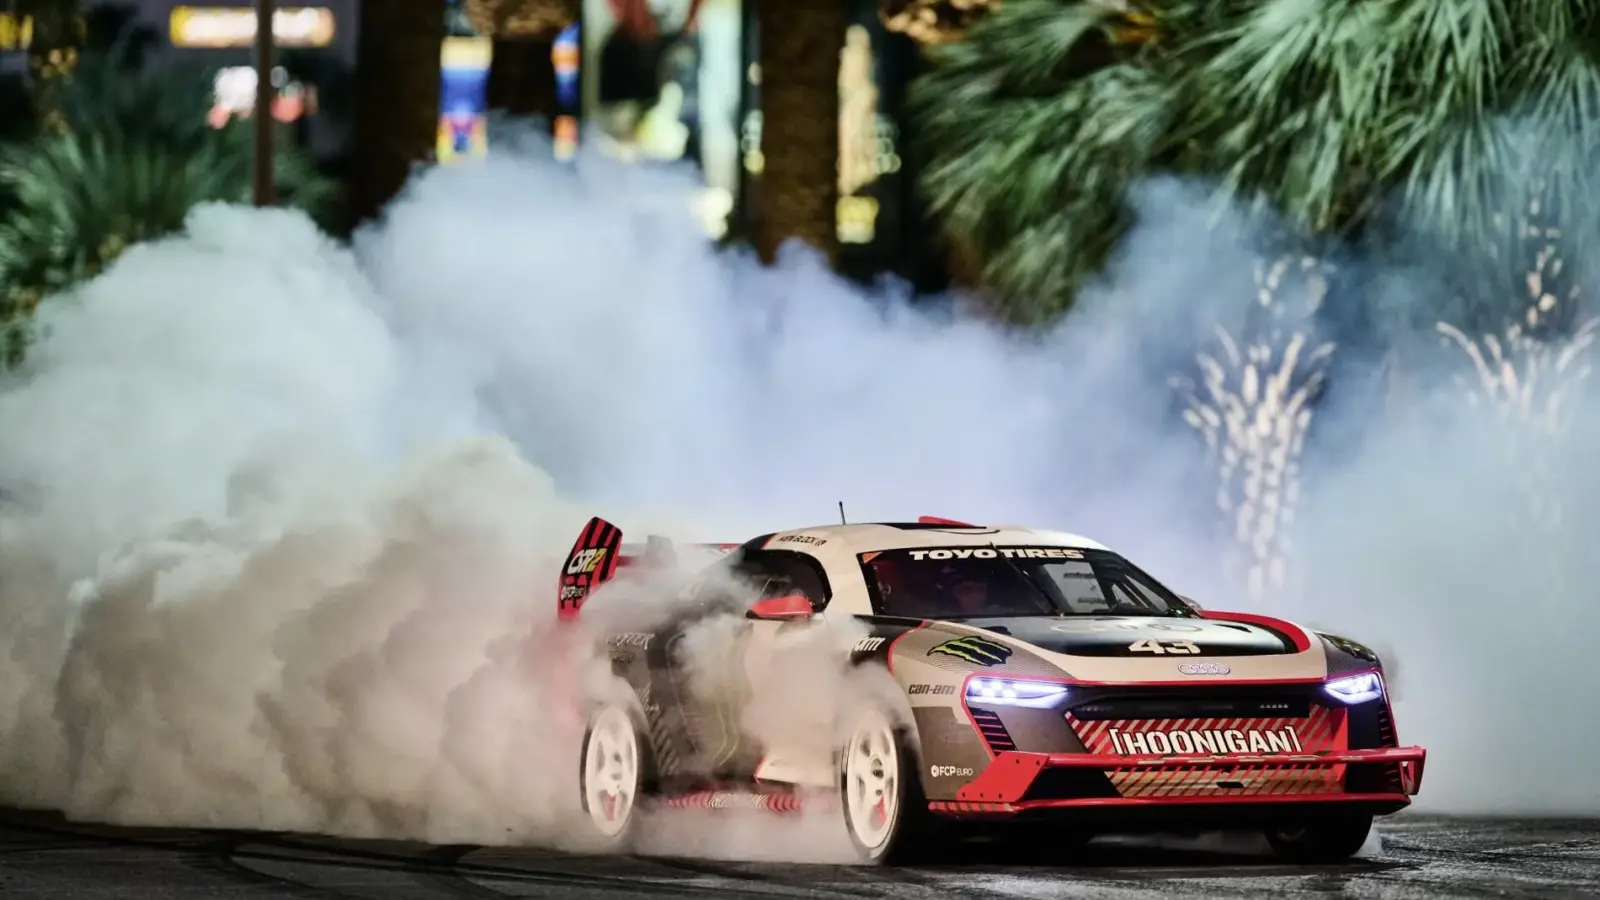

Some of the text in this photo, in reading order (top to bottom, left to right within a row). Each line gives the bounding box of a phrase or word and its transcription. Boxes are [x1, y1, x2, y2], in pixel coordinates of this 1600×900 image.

[909, 549, 1084, 561] TOYO TIRES
[1128, 638, 1201, 654] 43
[908, 684, 955, 695] can-am
[939, 765, 956, 777] FCP
